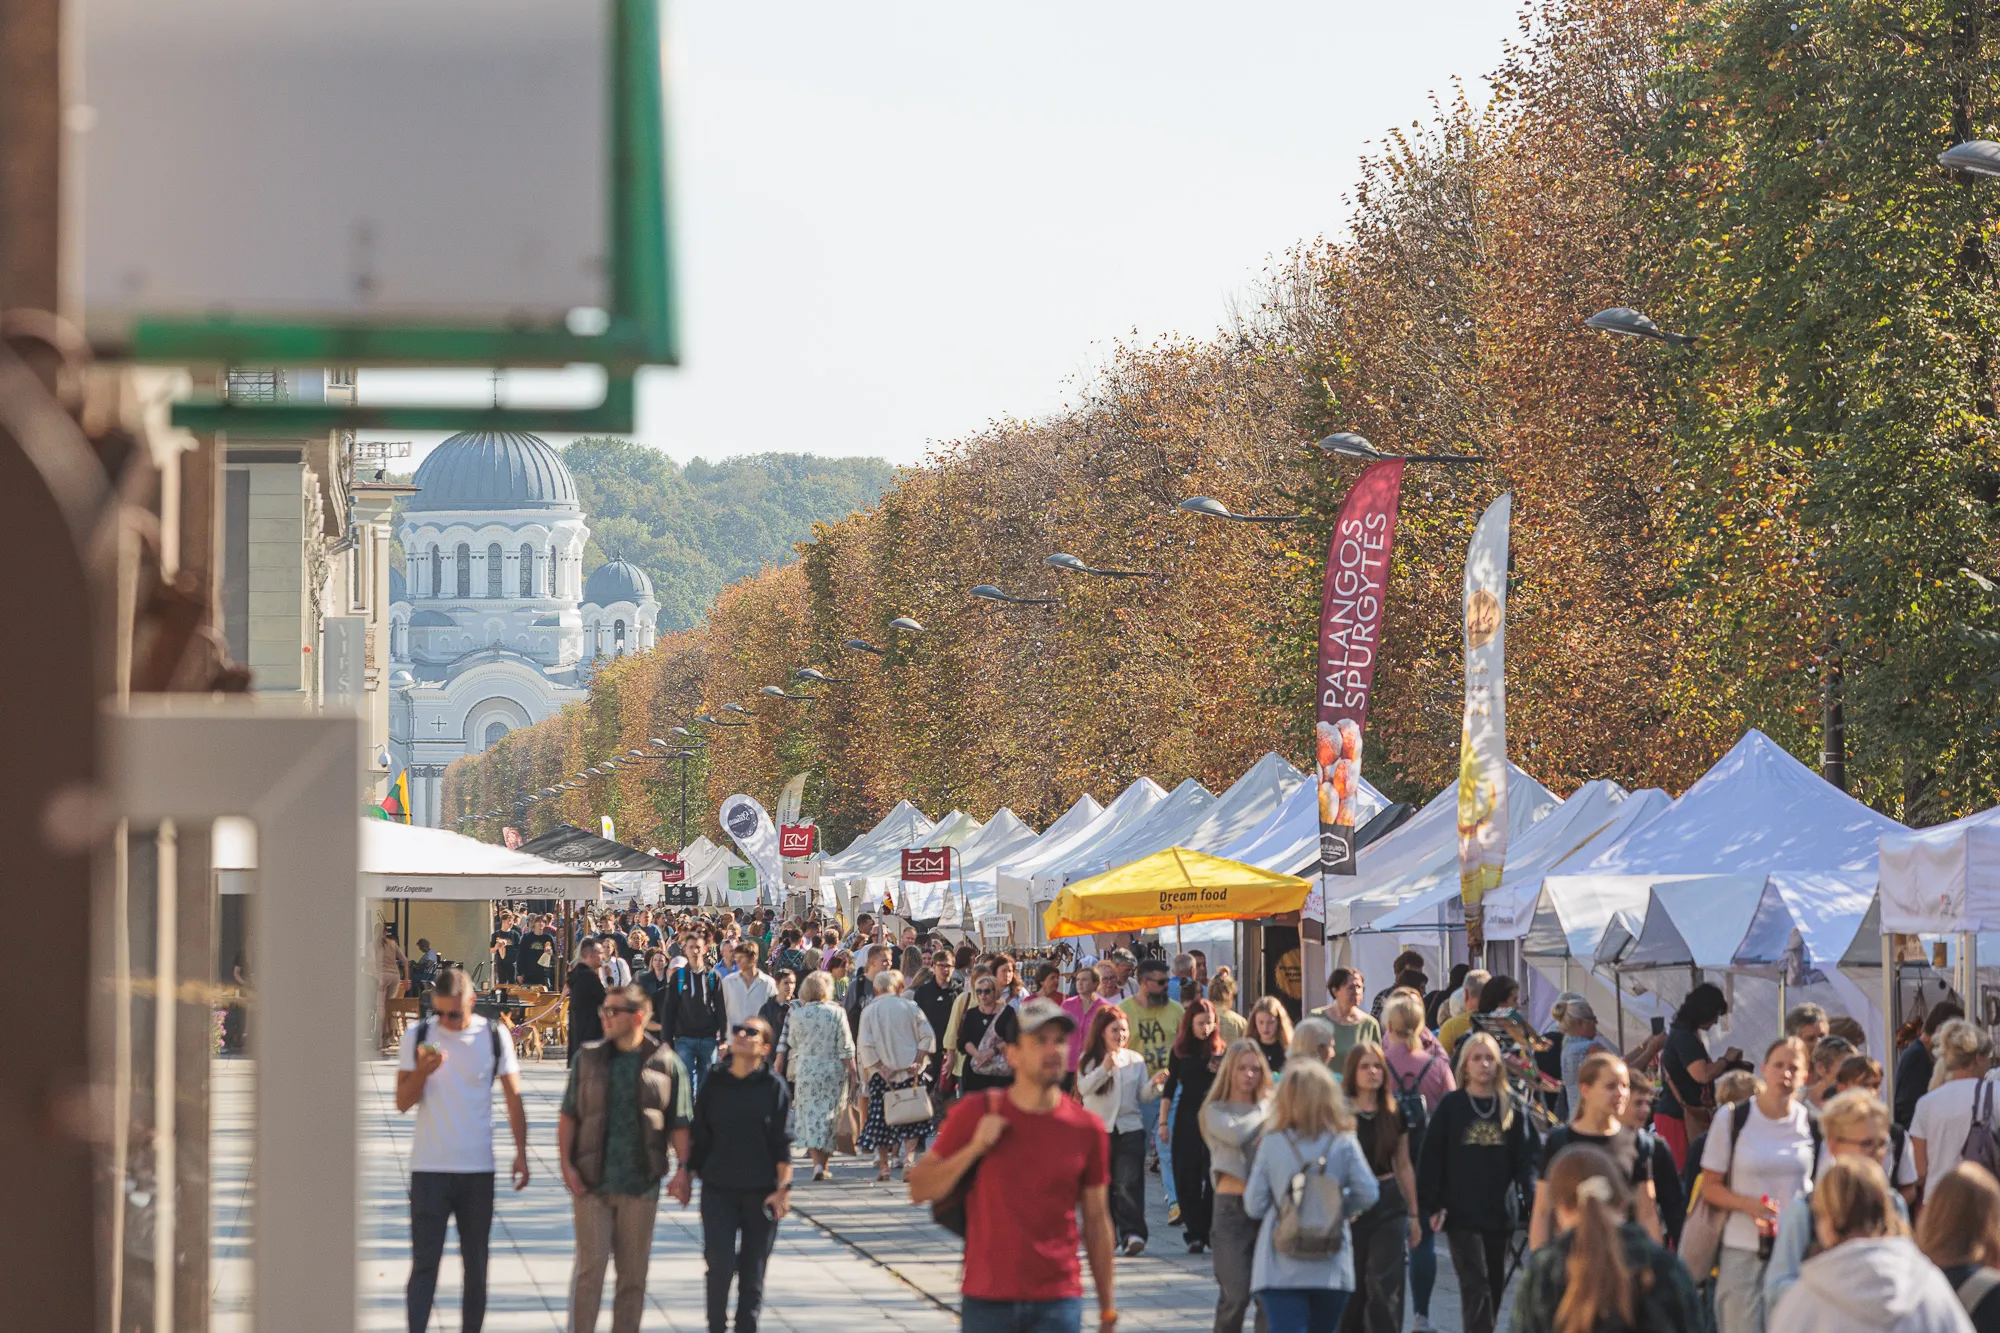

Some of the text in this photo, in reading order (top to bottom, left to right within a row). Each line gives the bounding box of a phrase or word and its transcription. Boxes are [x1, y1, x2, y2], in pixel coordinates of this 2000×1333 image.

[1323, 519, 1364, 708] PALANGOS
[525, 885, 566, 898] Stanley
[1159, 887, 1228, 903] Dream food
